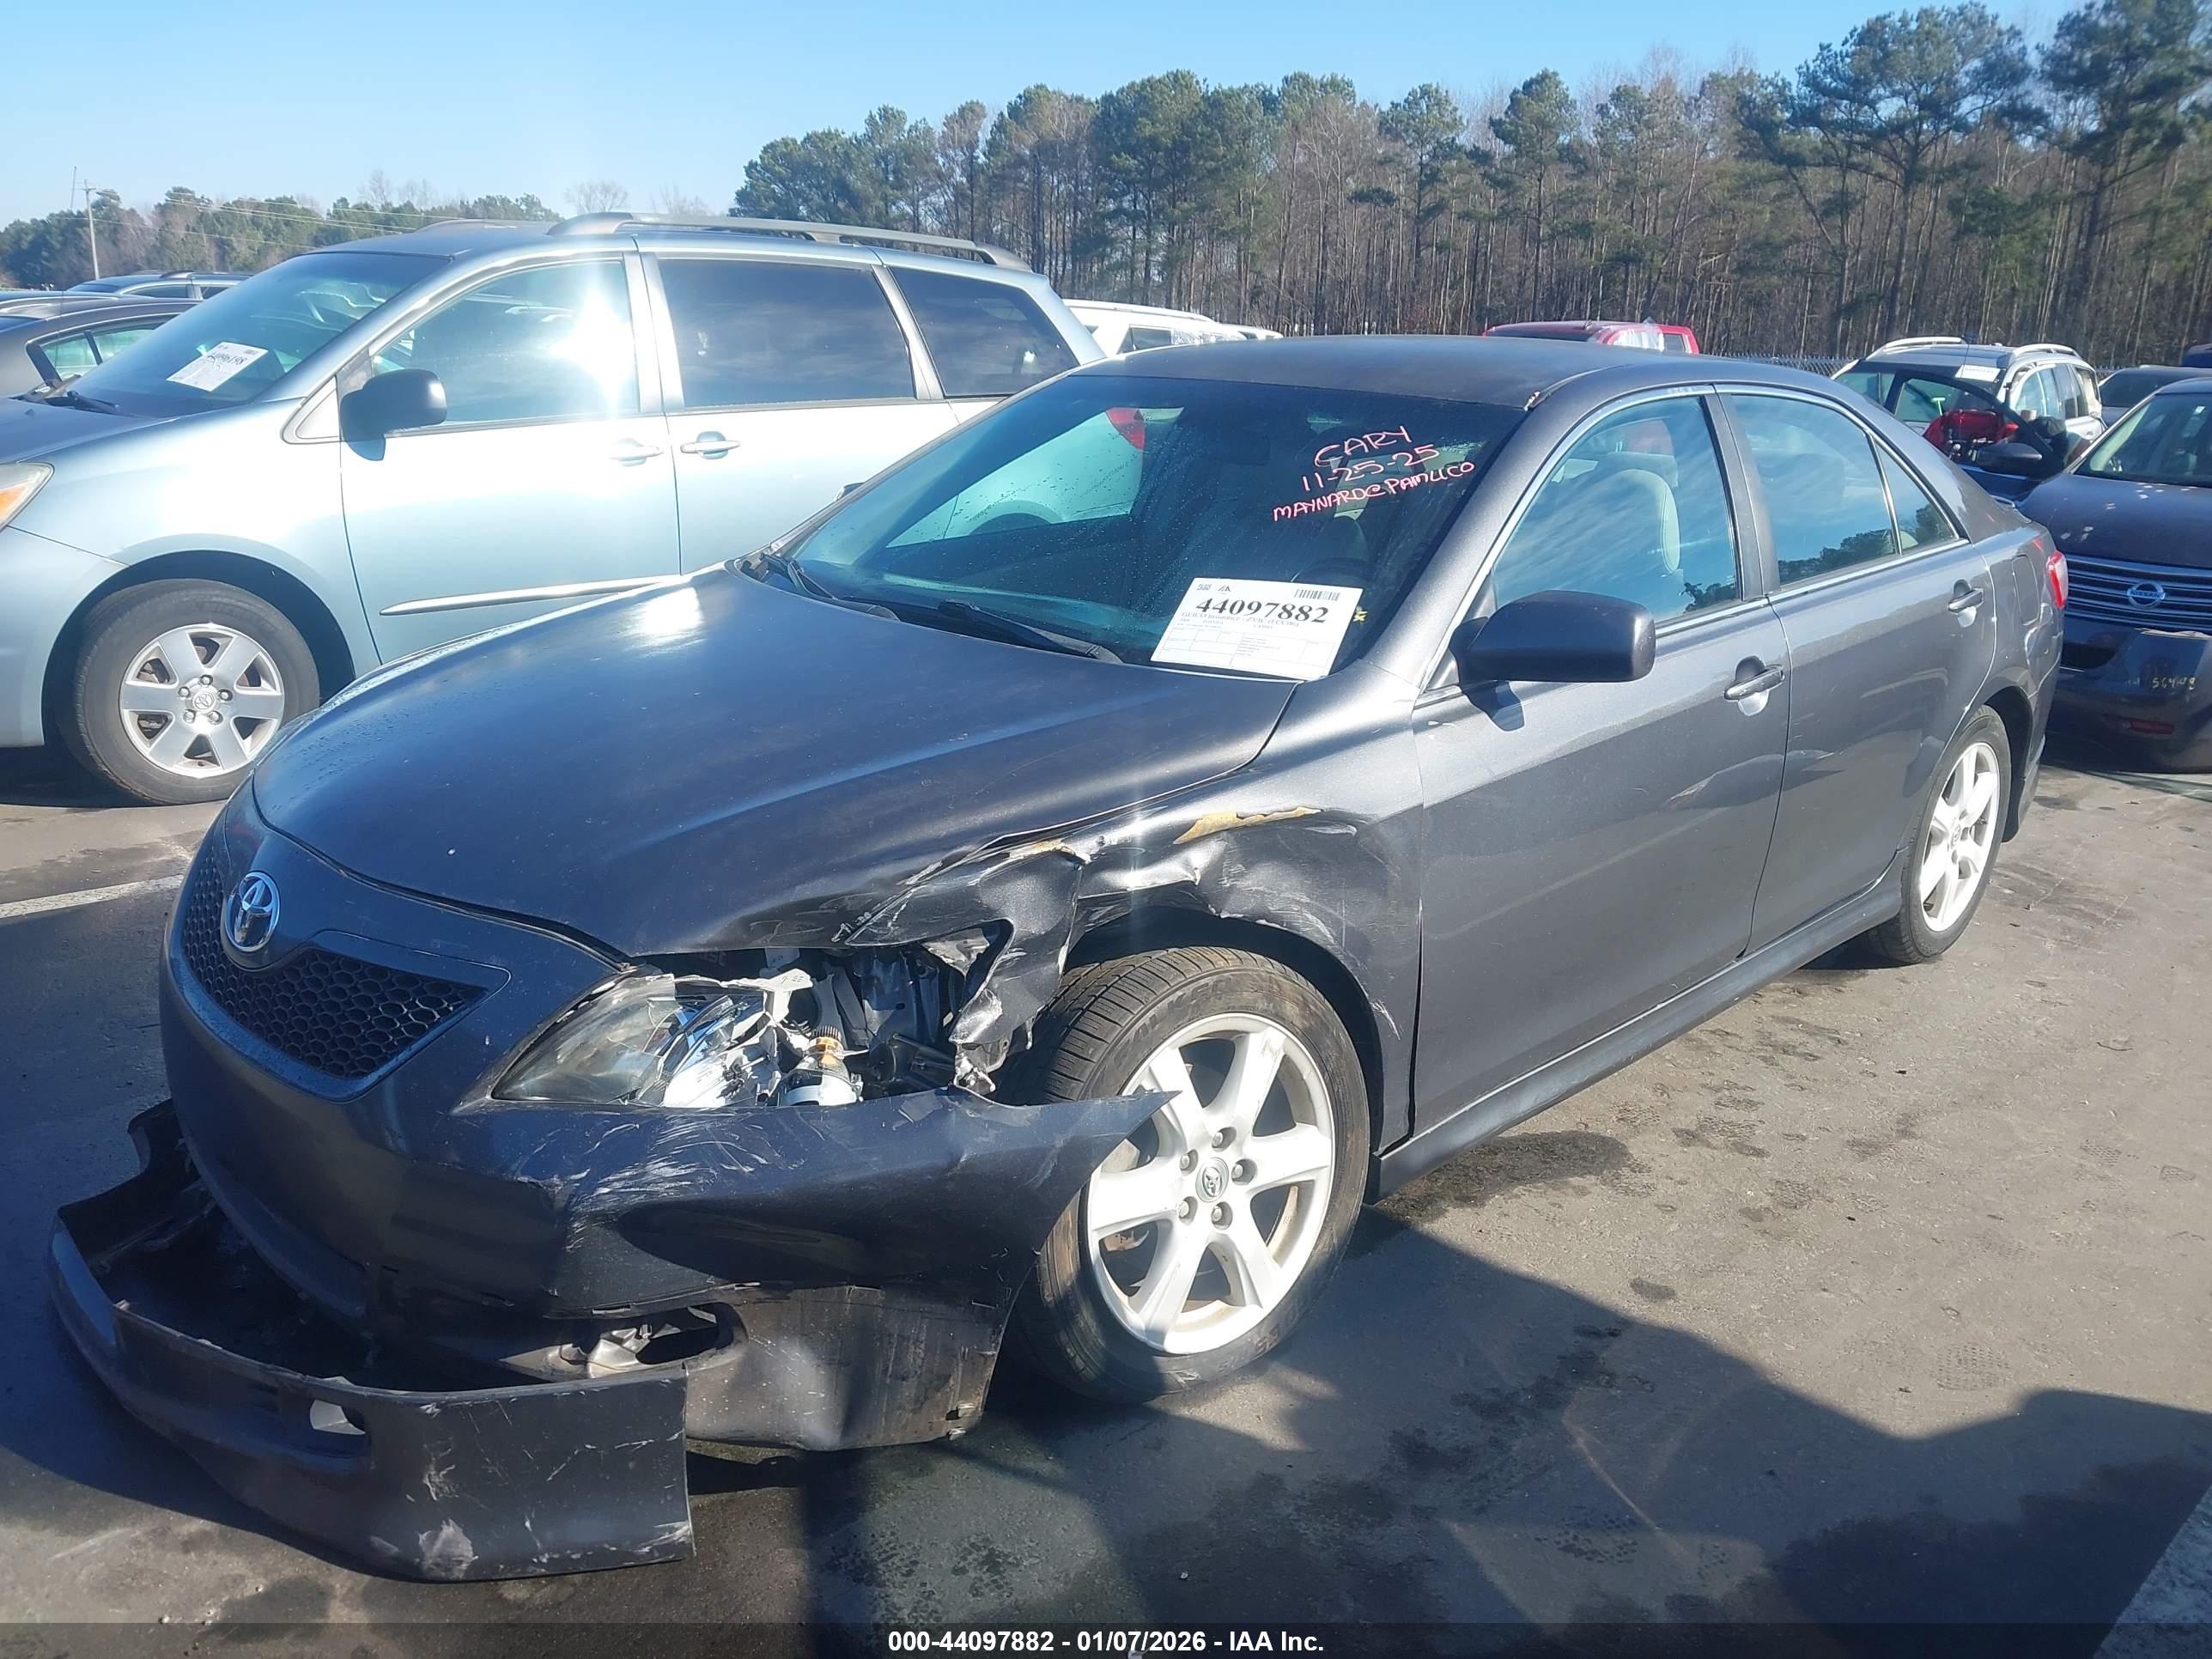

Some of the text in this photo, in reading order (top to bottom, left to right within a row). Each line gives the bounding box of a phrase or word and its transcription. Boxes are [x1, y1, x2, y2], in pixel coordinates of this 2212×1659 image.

[1314, 425, 1413, 466] CARY
[1302, 443, 1440, 491] 11-25-25
[1195, 598, 1329, 624] 44097882
